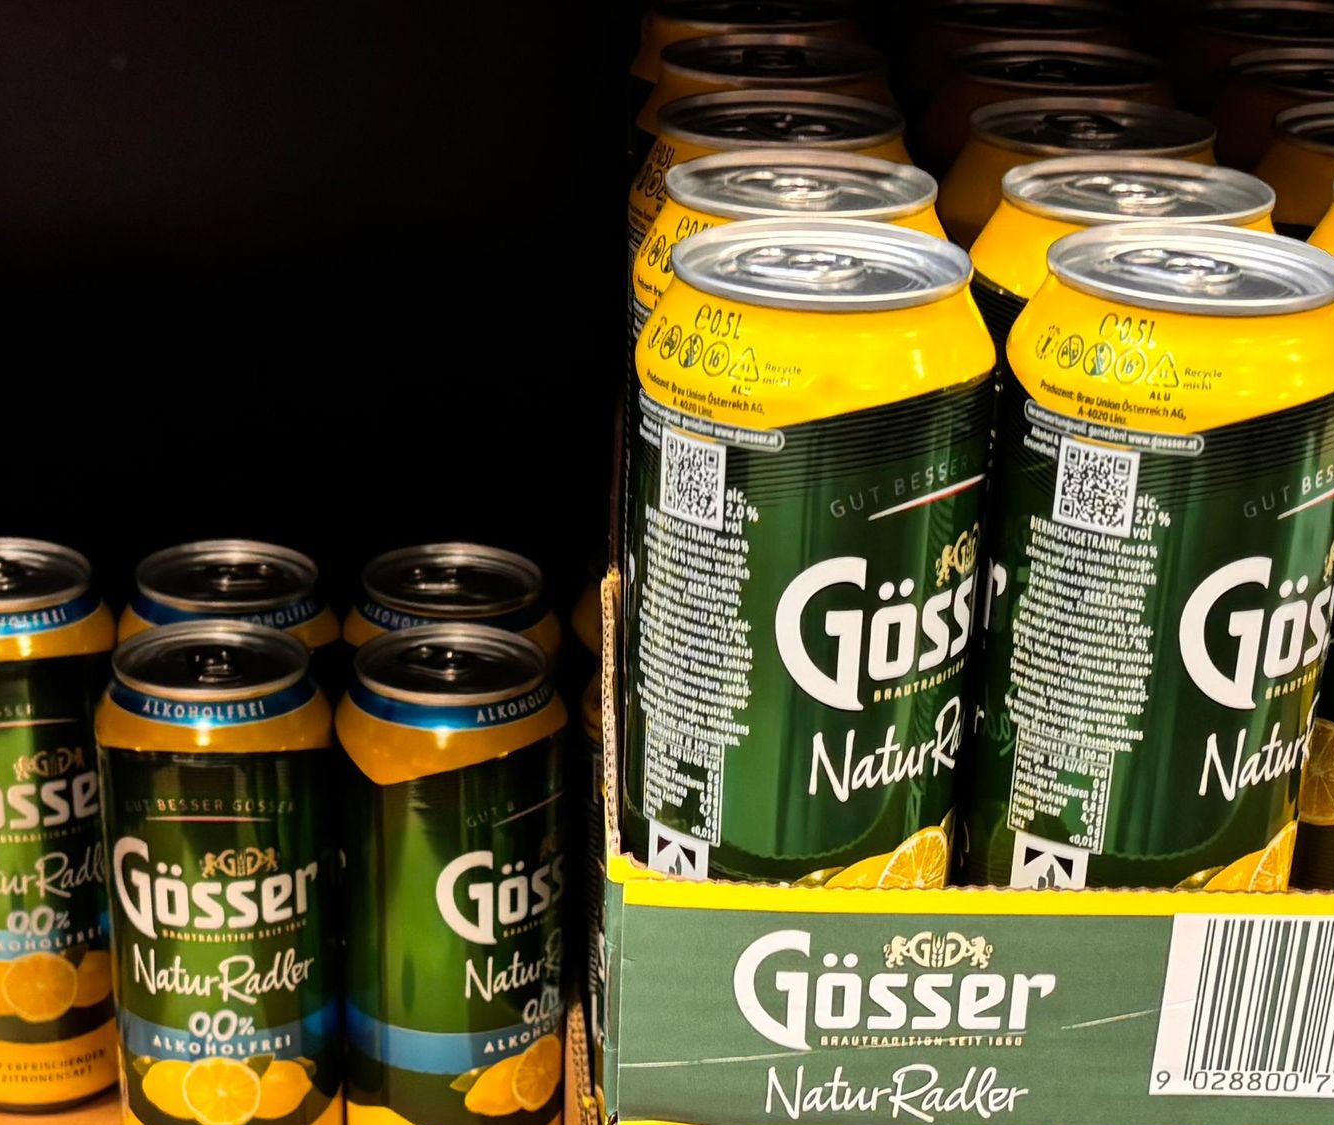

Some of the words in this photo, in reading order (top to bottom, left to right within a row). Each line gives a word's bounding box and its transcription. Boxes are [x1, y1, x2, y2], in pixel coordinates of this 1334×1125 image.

[775, 556, 977, 711] Göss
[142, 699, 266, 718] ALKOHOLFREI
[157, 798, 223, 812] BESSER
[113, 835, 318, 940] Gösser
[437, 849, 565, 944] Göss
[733, 929, 1055, 1050] Gösser
[153, 1034, 291, 1054] ALKOHOLFREI
[820, 1036, 944, 1047] BRAUTRADITION
[949, 1036, 983, 1047] SEIT
[987, 1036, 1022, 1046] 1860
[1156, 1071, 1170, 1091] 9
[1192, 1070, 1298, 1095] 028800
